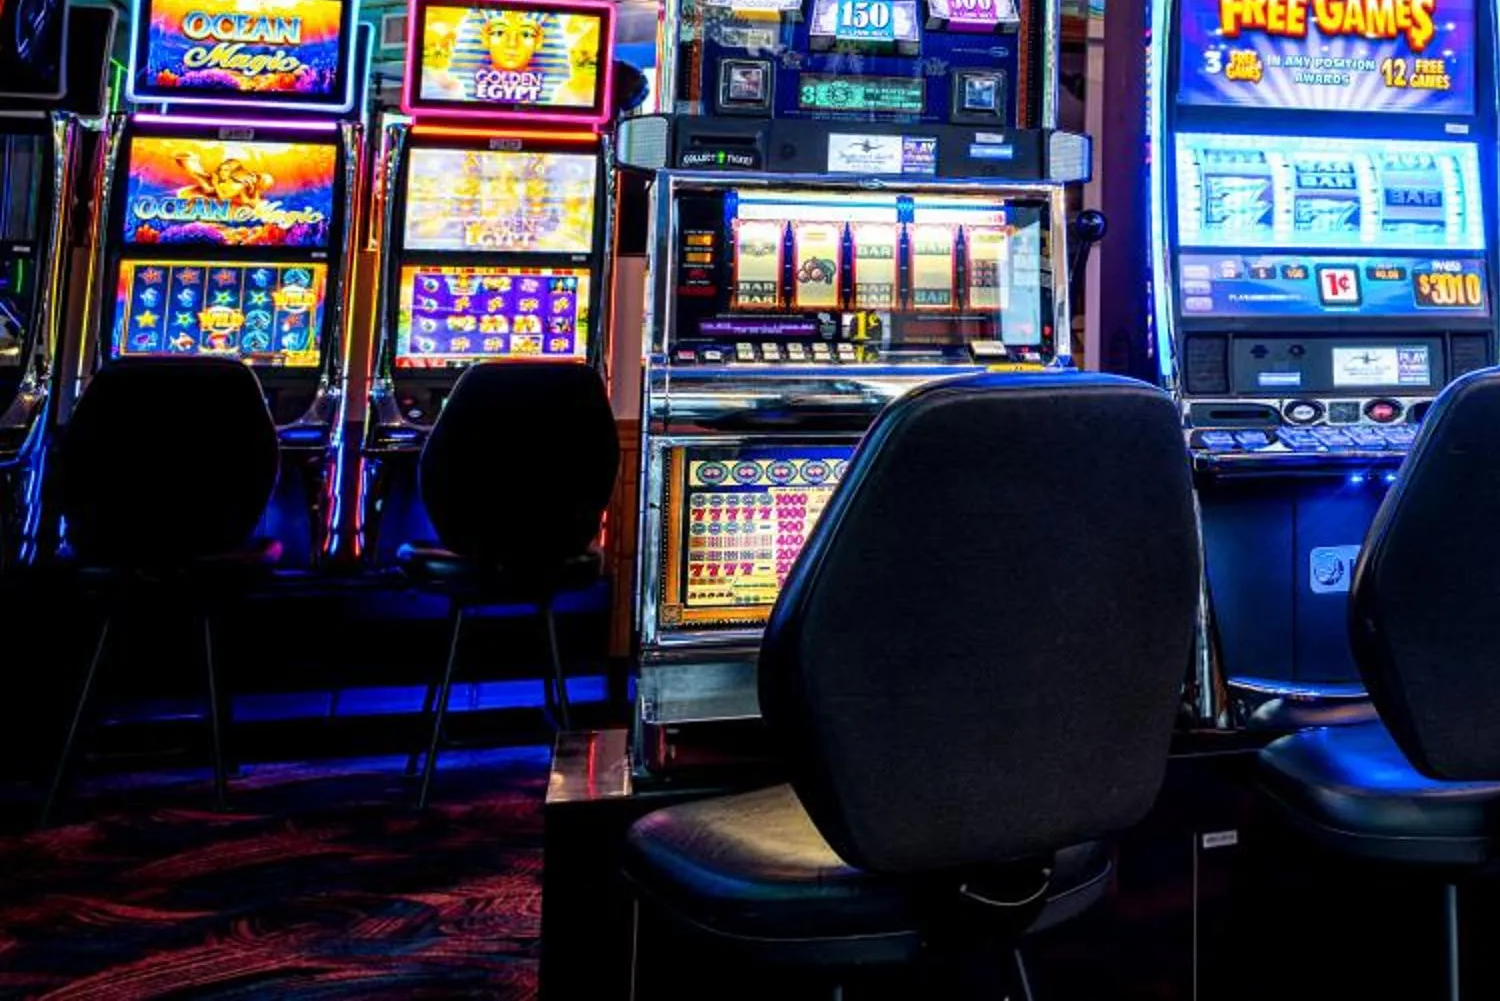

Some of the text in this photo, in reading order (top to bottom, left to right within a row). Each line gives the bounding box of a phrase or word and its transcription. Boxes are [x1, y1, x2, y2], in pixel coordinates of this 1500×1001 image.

[841, 1, 889, 29] 150
[182, 10, 302, 45] OCEAN
[182, 42, 307, 76] Magic
[1204, 50, 1223, 74] 3
[1267, 55, 1377, 72] IN ANY POSITION
[1415, 59, 1446, 75] FREE
[474, 69, 543, 87] GOLDEN
[1381, 58, 1407, 88] 12
[1409, 73, 1451, 90] GAMES
[475, 83, 543, 101] EGYPT
[131, 196, 231, 222] OCEAN
[857, 245, 892, 257] BAR
[1325, 272, 1351, 297] 1¢
[776, 534, 804, 545] 400
